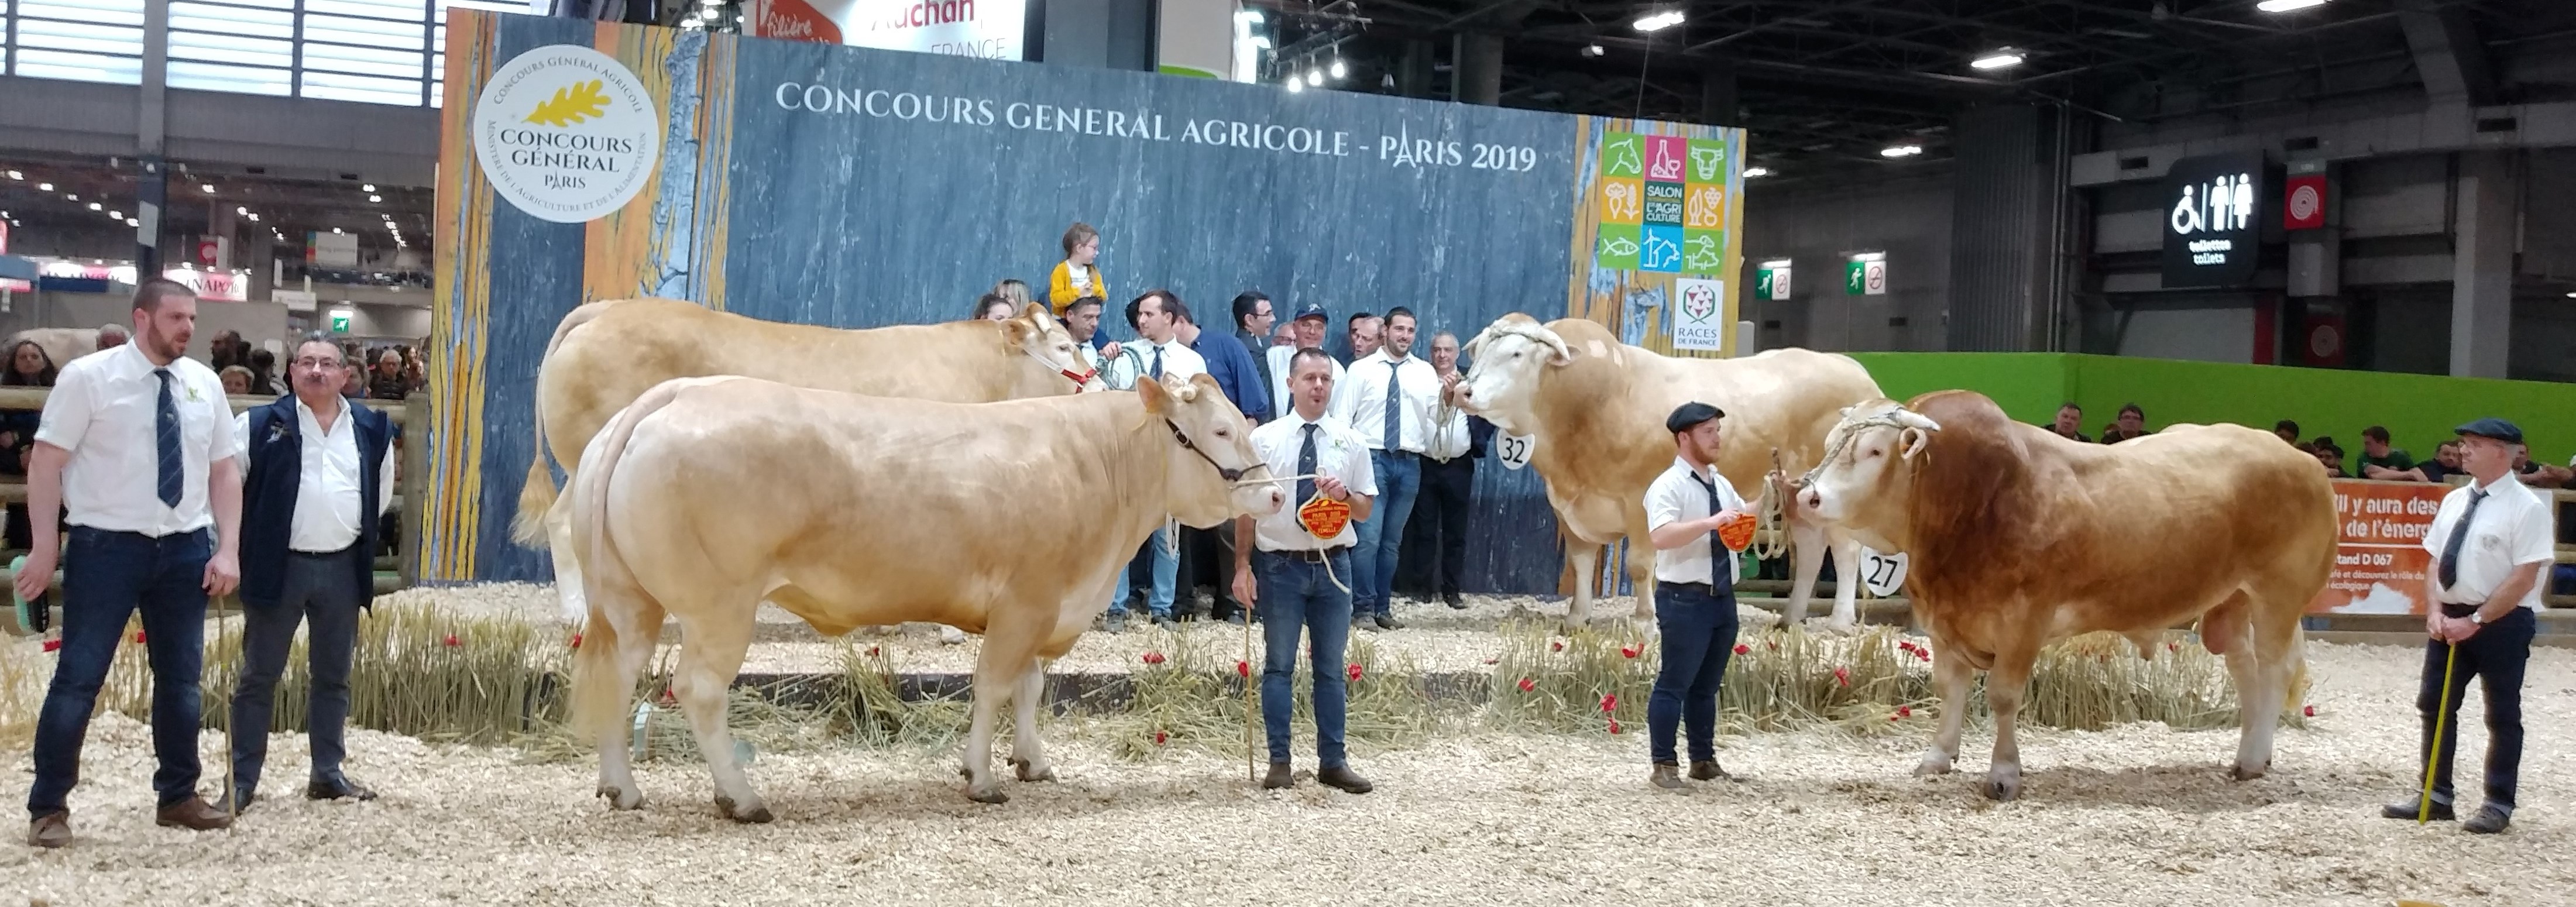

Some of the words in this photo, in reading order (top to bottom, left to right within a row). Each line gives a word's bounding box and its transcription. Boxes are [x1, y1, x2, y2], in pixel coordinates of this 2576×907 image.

[871, 0, 974, 31] uchan
[494, 61, 544, 104] CONCOURS
[601, 68, 643, 113] AGRICOLE
[775, 81, 995, 126] CONCOURS
[1006, 102, 1170, 142] GENERAL
[1181, 118, 1349, 157] AGRICOLE
[1379, 118, 1463, 168] PARIS
[1471, 143, 1537, 172] 2019
[500, 128, 632, 154] CONCOURS
[511, 147, 620, 173] GÉNÉRAL
[545, 169, 586, 190] PARIS
[1647, 185, 1682, 199] SALON
[1646, 212, 1681, 223] CULTURE
[2193, 252, 2225, 265] toilets
[1678, 328, 1717, 338] RACES
[1502, 437, 1524, 463] 32
[2352, 498, 2363, 517] y
[2367, 499, 2402, 514] aura
[2406, 496, 2438, 516] des
[2346, 519, 2368, 537] de
[2372, 518, 2431, 540] l'énerg
[2334, 553, 2360, 565] tand
[2362, 553, 2371, 565] D
[2373, 554, 2393, 566] 067
[1867, 556, 1898, 588] 27
[2352, 569, 2389, 579] découvrez
[2390, 571, 2398, 579] le
